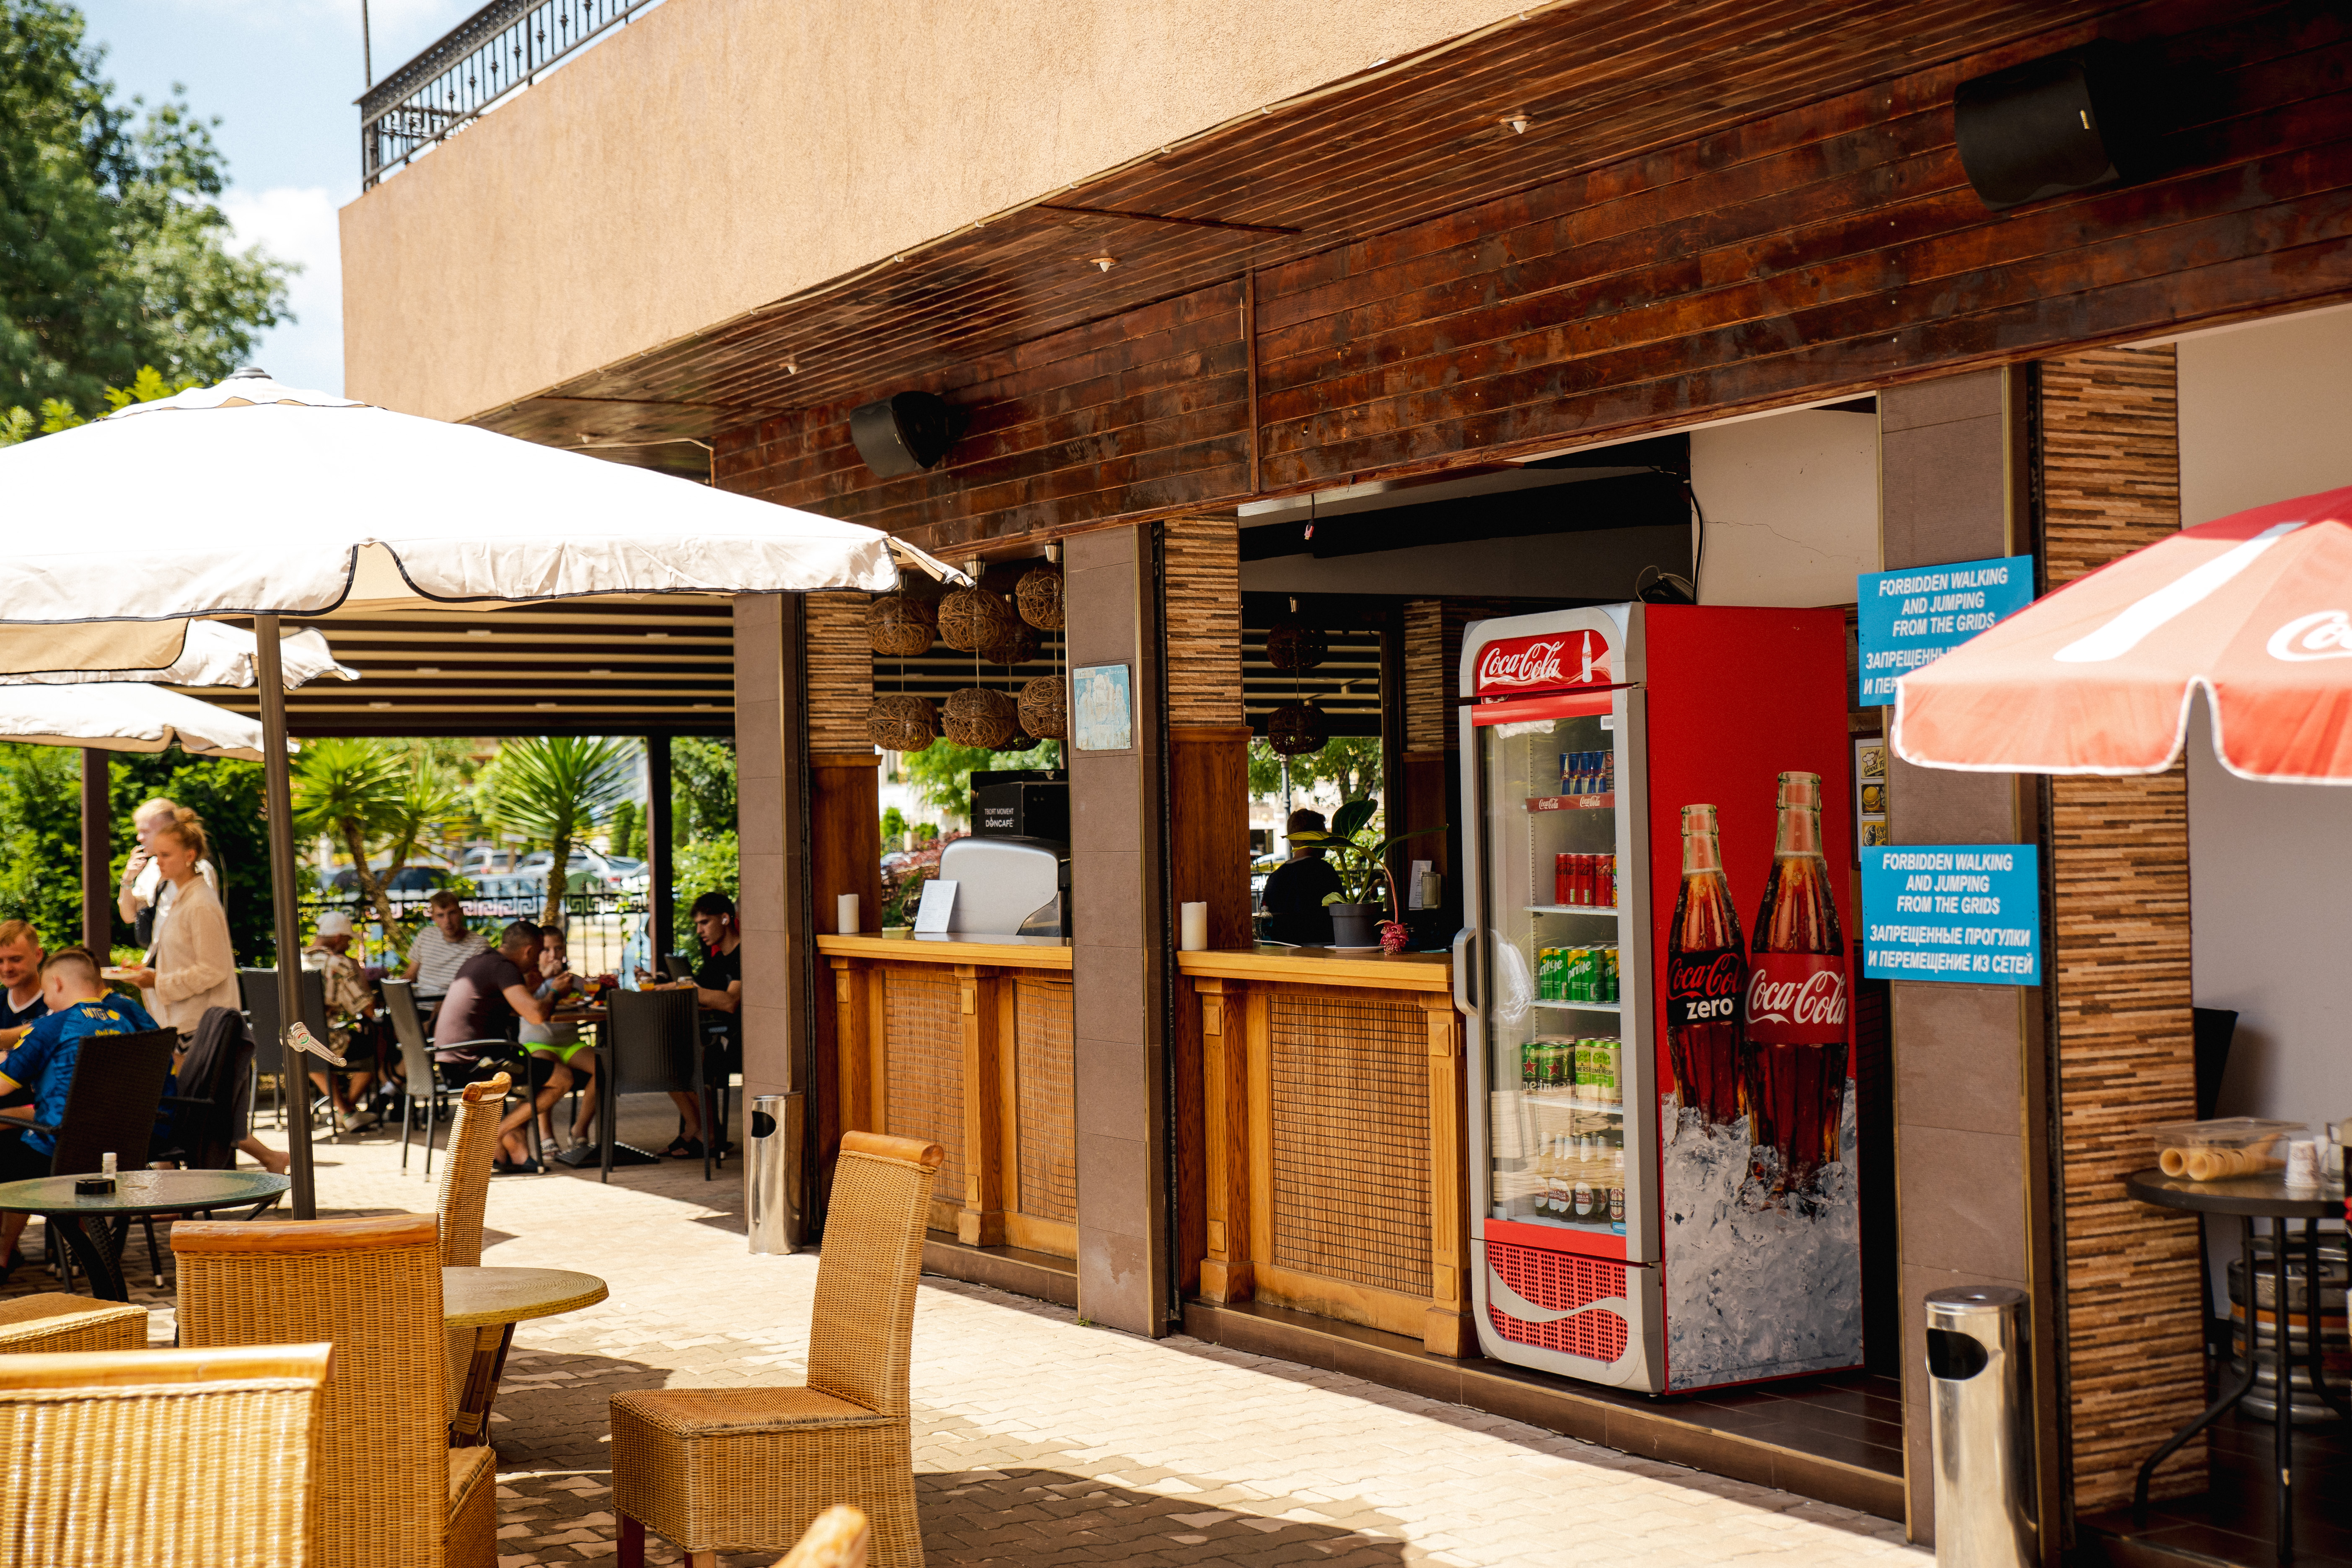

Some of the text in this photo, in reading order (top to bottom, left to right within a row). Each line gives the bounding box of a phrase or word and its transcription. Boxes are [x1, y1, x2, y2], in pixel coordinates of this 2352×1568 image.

[1879, 567, 2008, 596] FORBIDDEN WALKING
[1901, 591, 1984, 615] AND JUMPING
[1893, 612, 1995, 637] FROM THE GRIDS
[1481, 640, 1565, 683] Coca-Cola
[1863, 679, 1873, 695] И
[1864, 762, 1878, 775] Good
[1539, 798, 1559, 810] Coca-Cola
[1580, 795, 1601, 808] Coca-Cola
[985, 817, 1013, 827] DONCAFÉ
[1883, 853, 2013, 871] FORBIDDEN WALKING
[1905, 875, 1990, 892] AND JUMPING
[1897, 895, 2000, 915] FROM THE GRIDS
[1870, 925, 2031, 947] ЗАПРЕЩЕННЫЕ ПРОГУЛКИ
[1868, 950, 2033, 974] И ПЕРЕМЕЩЕНИЕ ИЗ СЕТЕЙ
[1666, 953, 1746, 1000] Coca-Cola
[1745, 969, 1847, 1024] Coca-Cola
[1686, 998, 1733, 1019] zero
